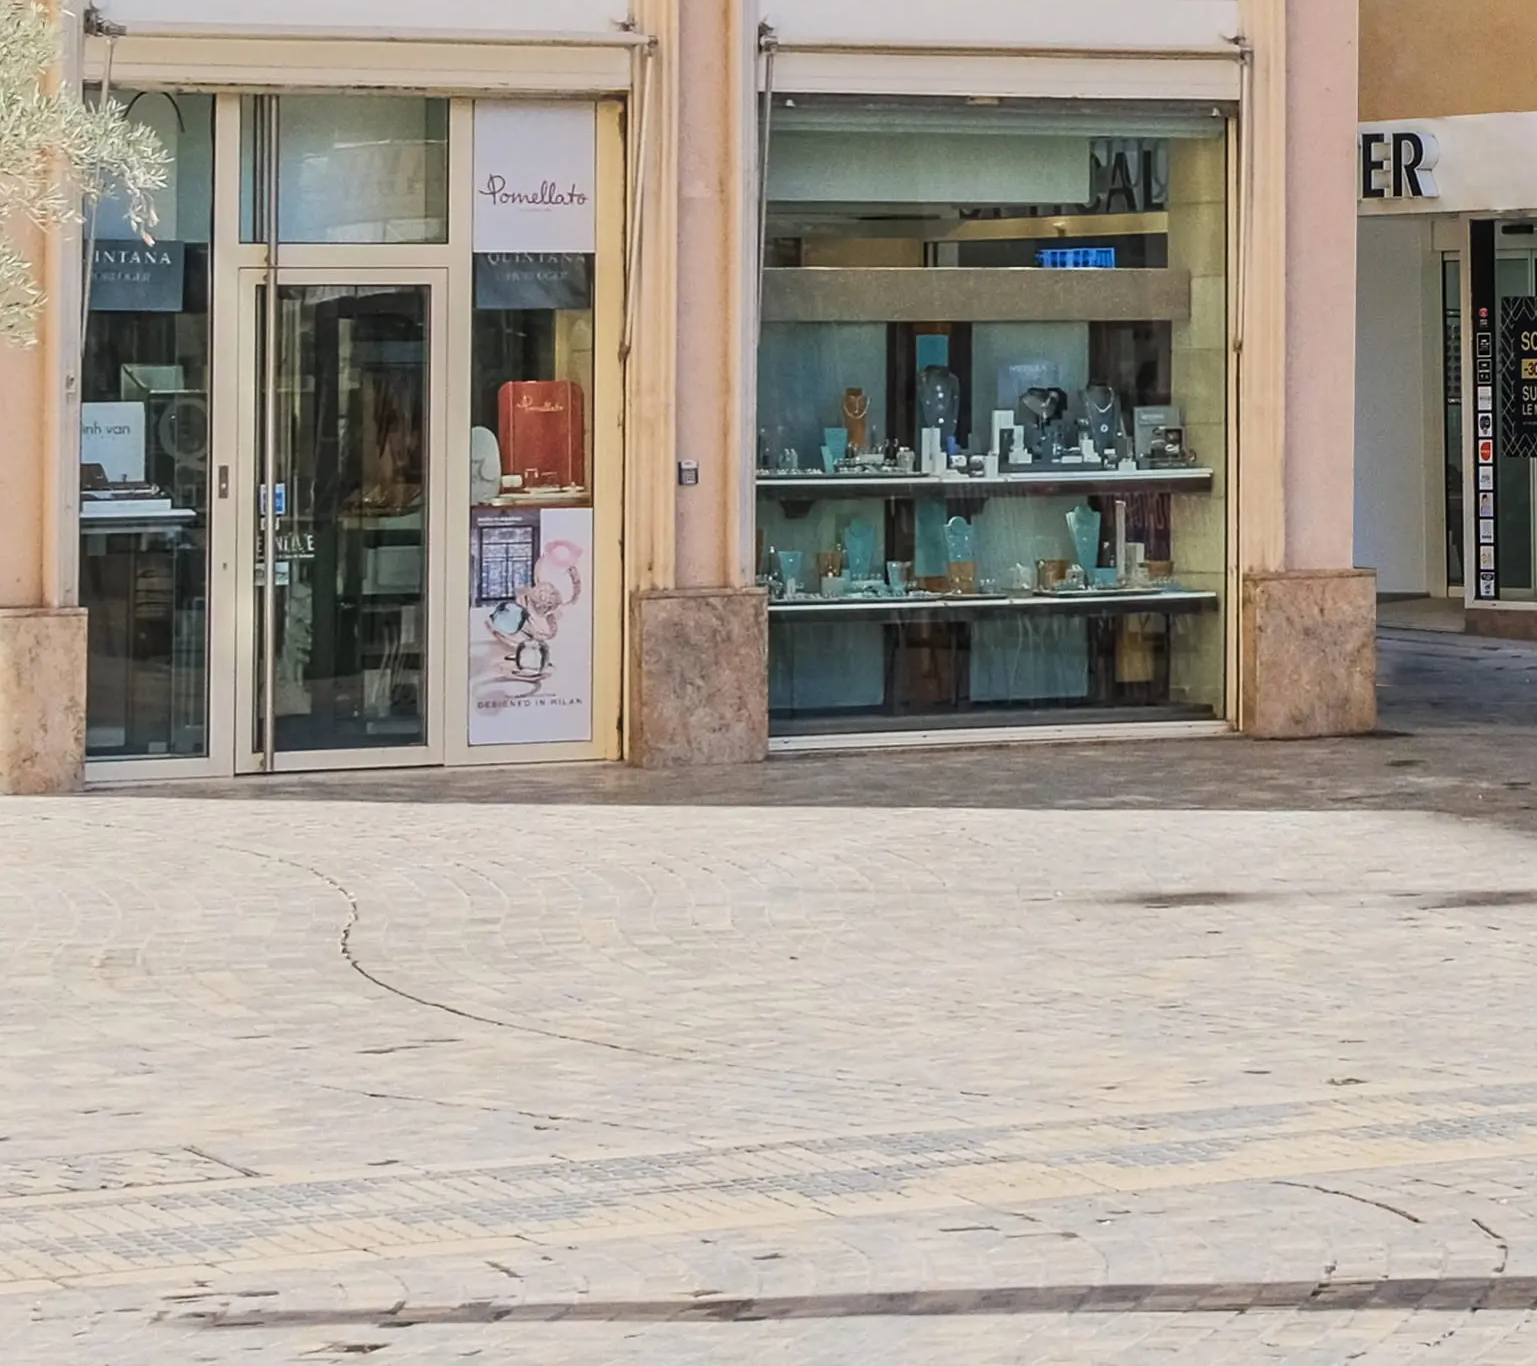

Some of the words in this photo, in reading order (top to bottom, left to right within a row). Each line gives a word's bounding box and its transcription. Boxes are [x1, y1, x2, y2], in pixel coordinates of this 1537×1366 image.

[479, 174, 588, 205] Pomellato
[94, 250, 171, 265] INTANA
[1522, 404, 1533, 415] LE
